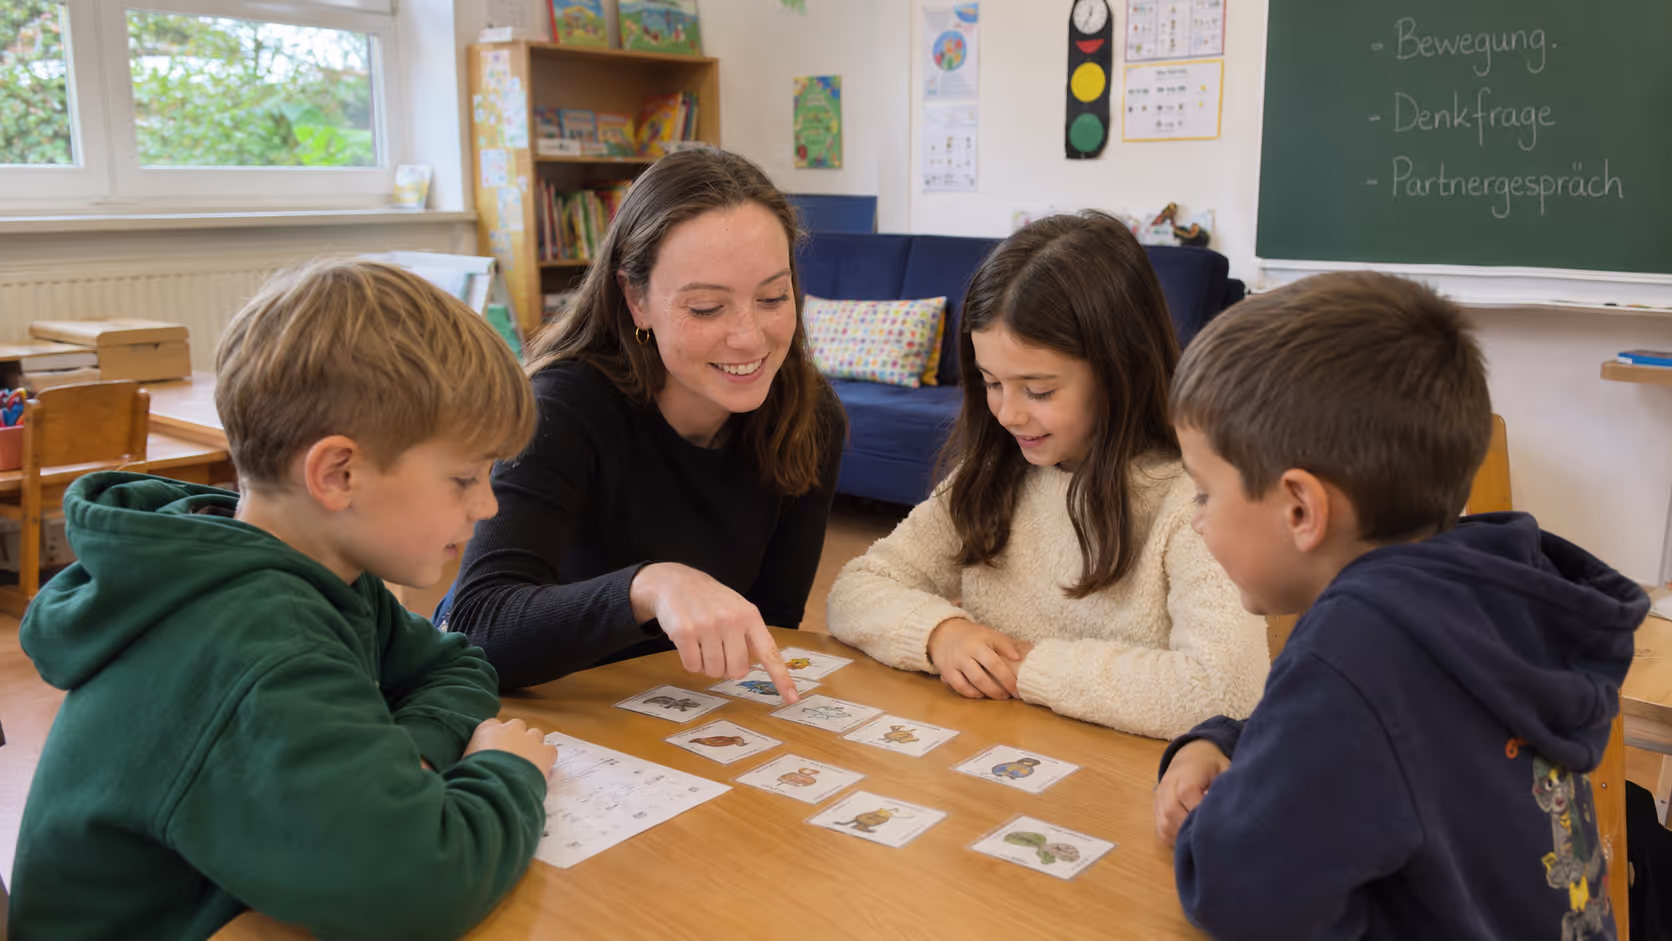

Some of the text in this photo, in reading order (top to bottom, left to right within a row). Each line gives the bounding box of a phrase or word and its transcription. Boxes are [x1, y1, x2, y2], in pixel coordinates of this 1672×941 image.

[1395, 16, 1558, 77] Bewegung.
[1393, 87, 1556, 151] Denkfrage
[1392, 155, 1624, 219] Partnergespräch
